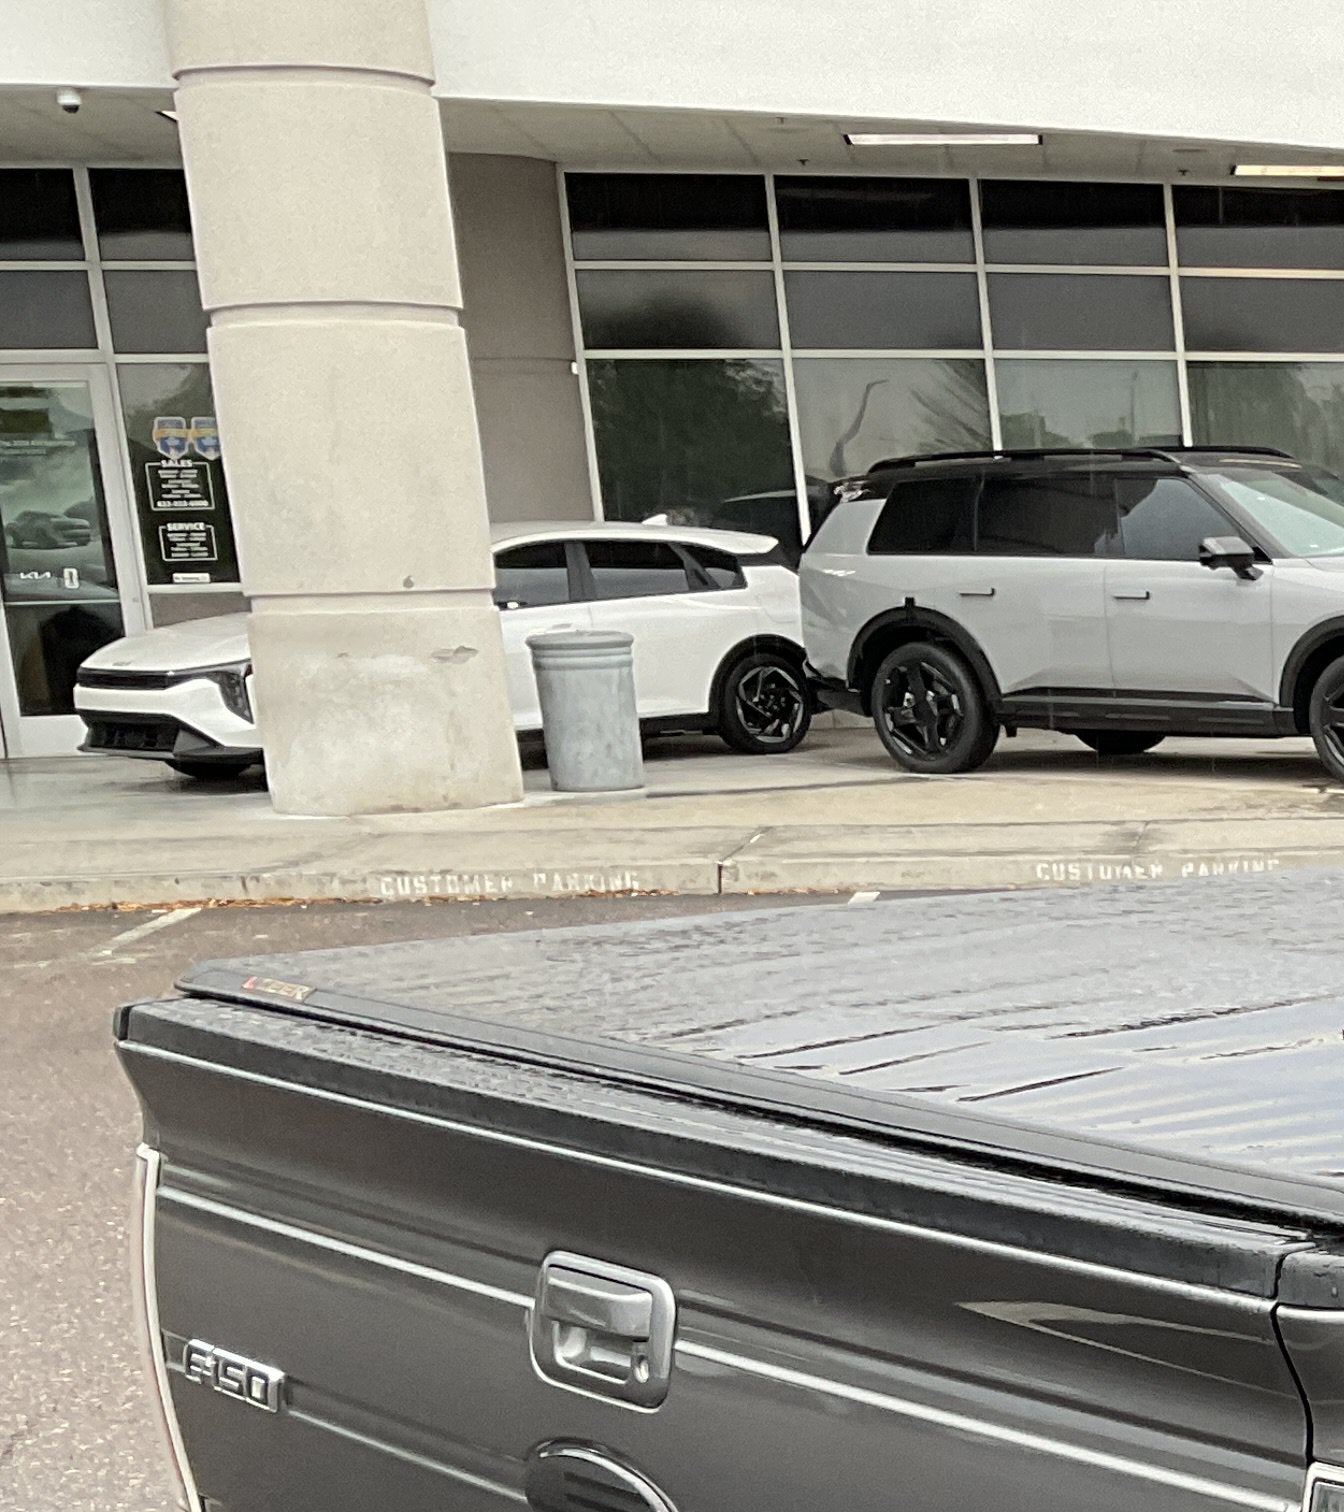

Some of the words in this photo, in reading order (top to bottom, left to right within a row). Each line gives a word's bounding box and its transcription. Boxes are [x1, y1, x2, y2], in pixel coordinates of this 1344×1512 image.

[166, 522, 206, 531] SERVICE
[380, 874, 512, 895] CUSTOMER
[533, 871, 640, 891] PARKING
